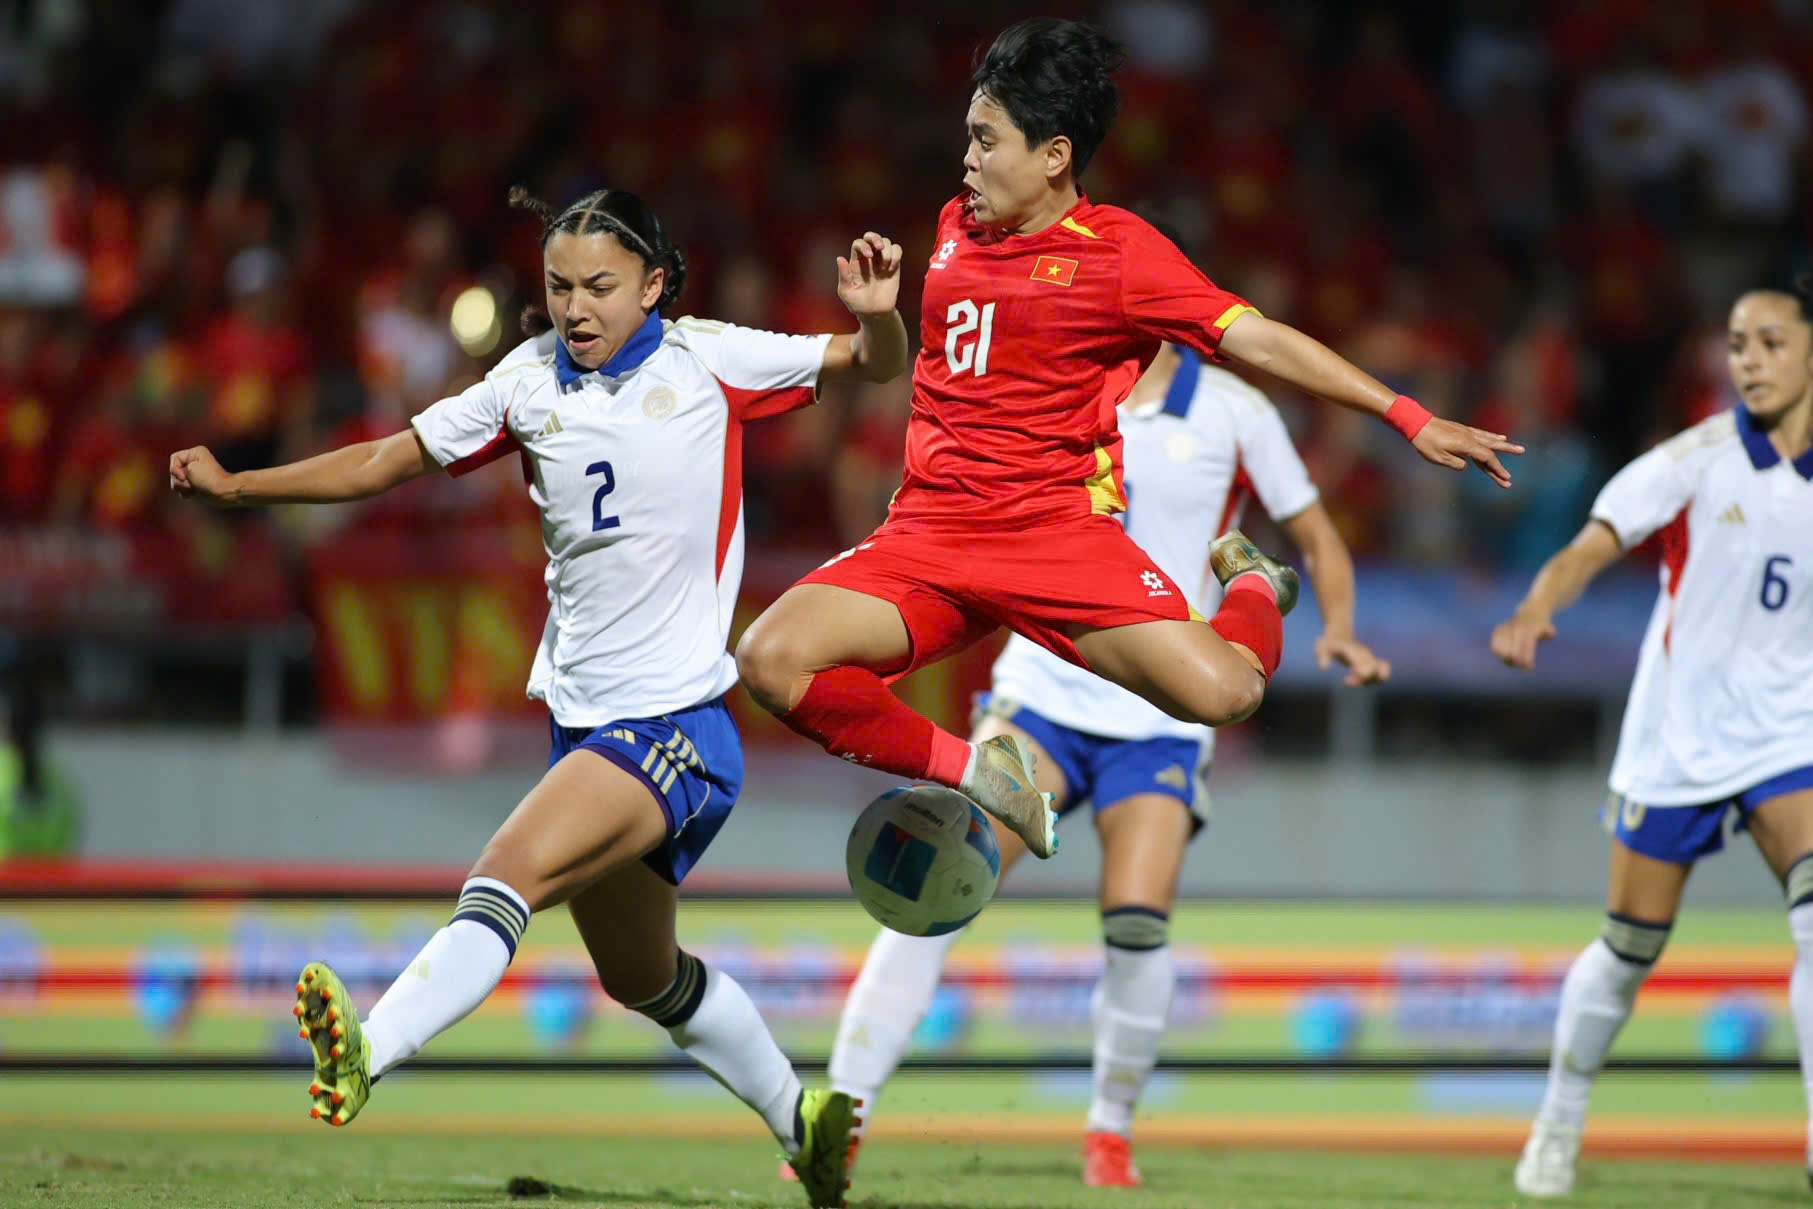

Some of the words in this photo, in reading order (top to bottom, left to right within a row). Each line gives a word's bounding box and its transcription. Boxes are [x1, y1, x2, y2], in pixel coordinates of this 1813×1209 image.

[945, 298, 996, 378] 21
[585, 460, 621, 532] 2
[1760, 556, 1793, 611] 6
